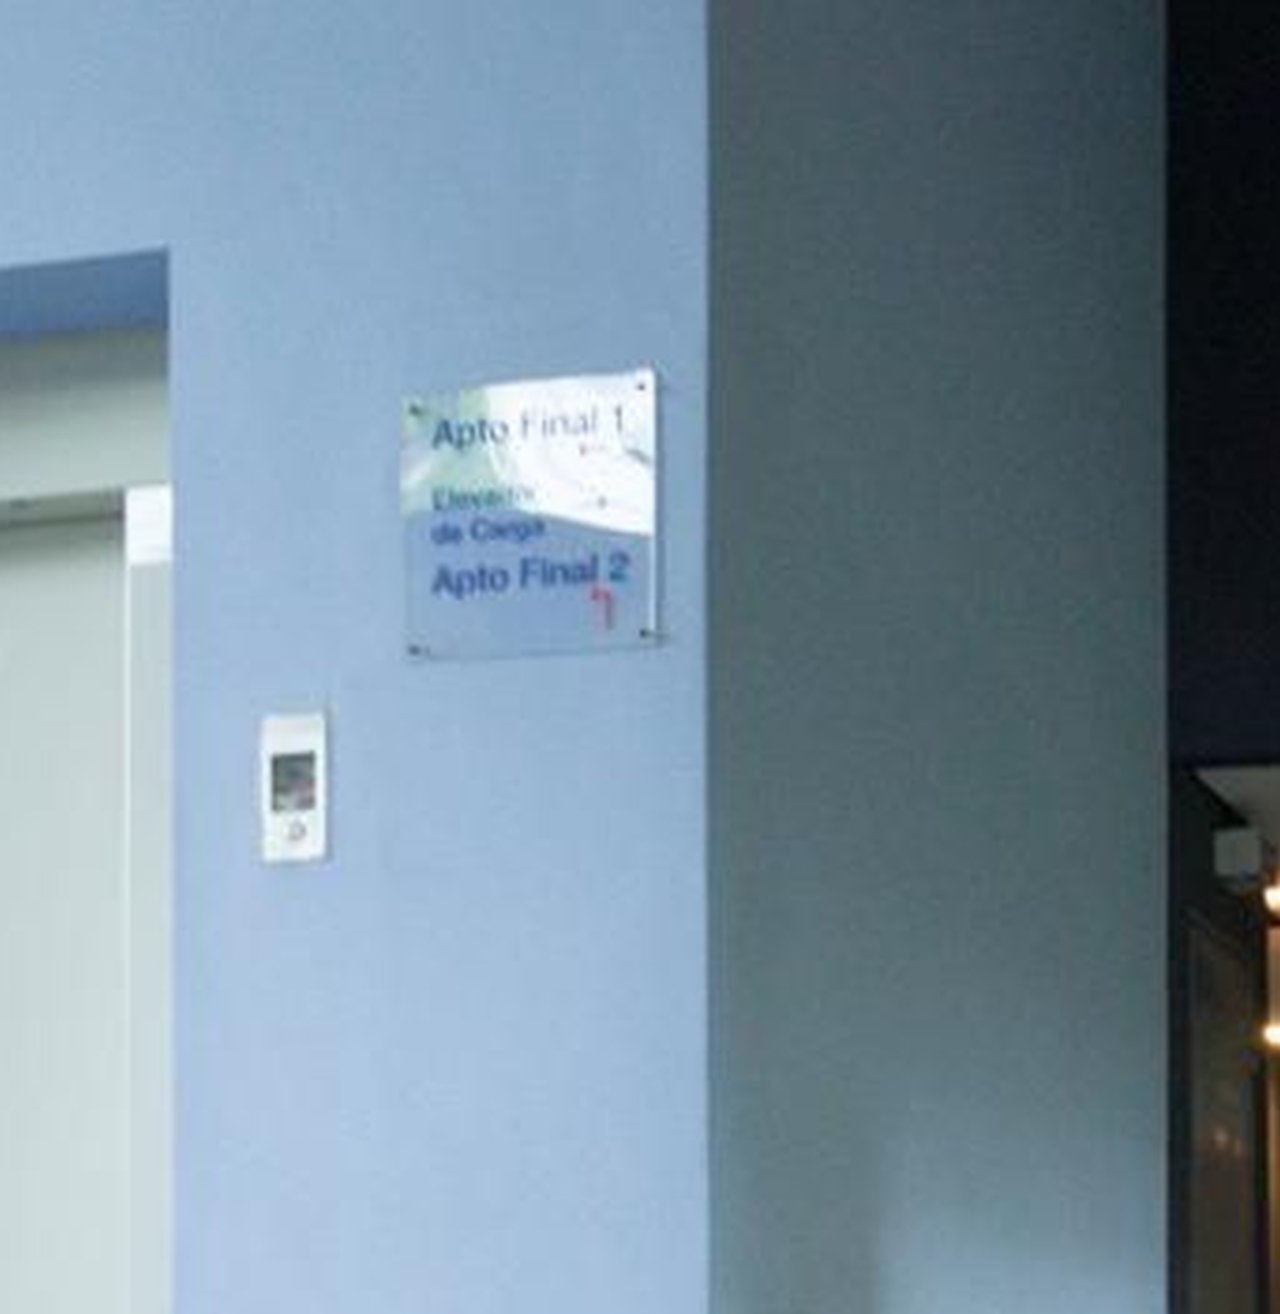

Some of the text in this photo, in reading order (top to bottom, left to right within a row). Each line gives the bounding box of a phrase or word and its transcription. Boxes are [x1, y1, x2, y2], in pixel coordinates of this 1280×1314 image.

[431, 417, 509, 450] Apto
[521, 404, 598, 440] Final
[469, 516, 547, 545] Carga
[431, 550, 631, 600] Apto Final 2
